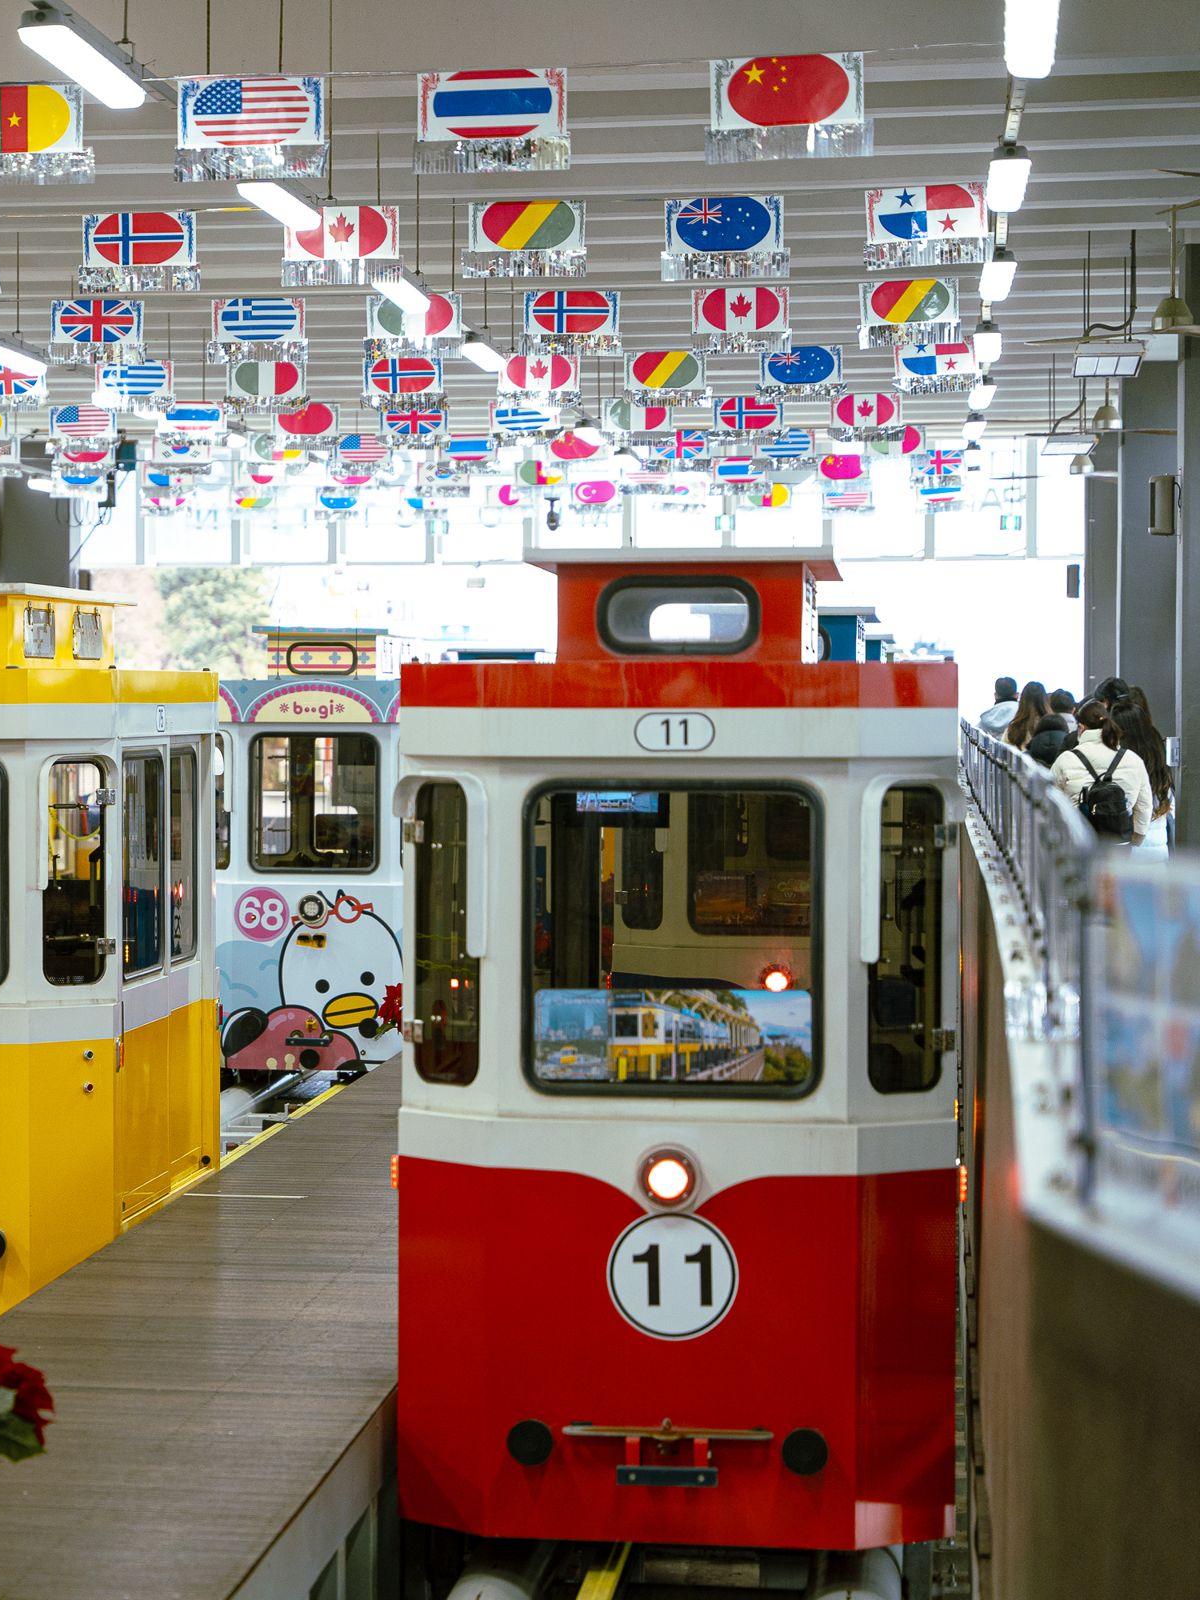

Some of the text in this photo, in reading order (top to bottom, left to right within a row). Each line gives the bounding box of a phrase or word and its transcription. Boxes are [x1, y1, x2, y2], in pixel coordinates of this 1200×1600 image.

[660, 718, 689, 746] 11
[239, 896, 284, 931] 68
[632, 1243, 712, 1307] 11
